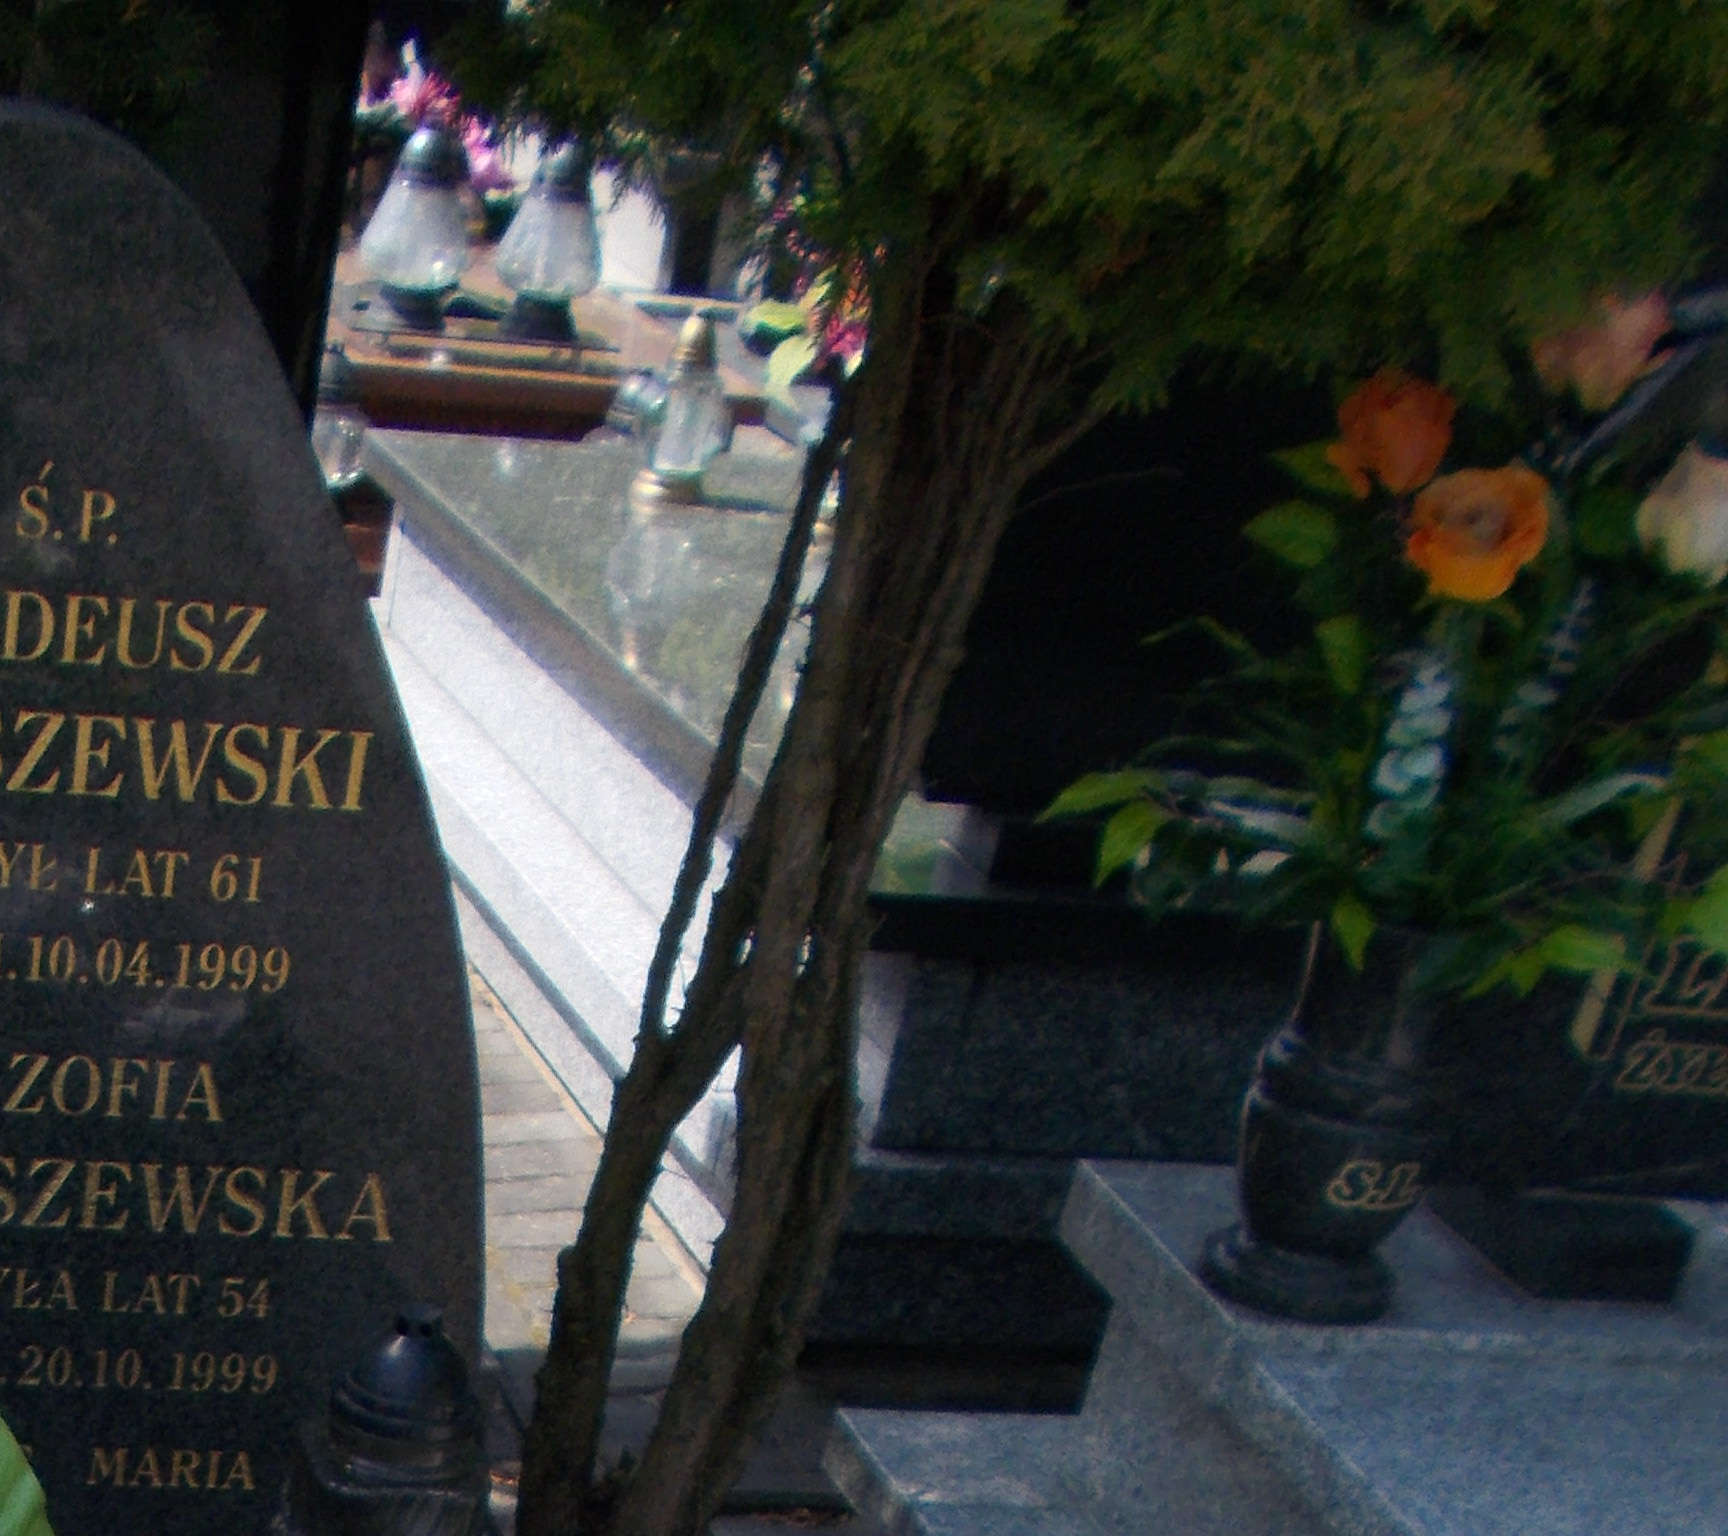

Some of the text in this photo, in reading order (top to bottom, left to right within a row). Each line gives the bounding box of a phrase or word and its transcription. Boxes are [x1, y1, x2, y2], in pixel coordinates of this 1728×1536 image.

[84, 847, 189, 899] LAT
[209, 853, 263, 902] 61
[2, 1052, 225, 1122] ZOFIA
[102, 1268, 201, 1315] LAT
[217, 1276, 273, 1318] 54
[86, 1447, 257, 1491] MARIA
